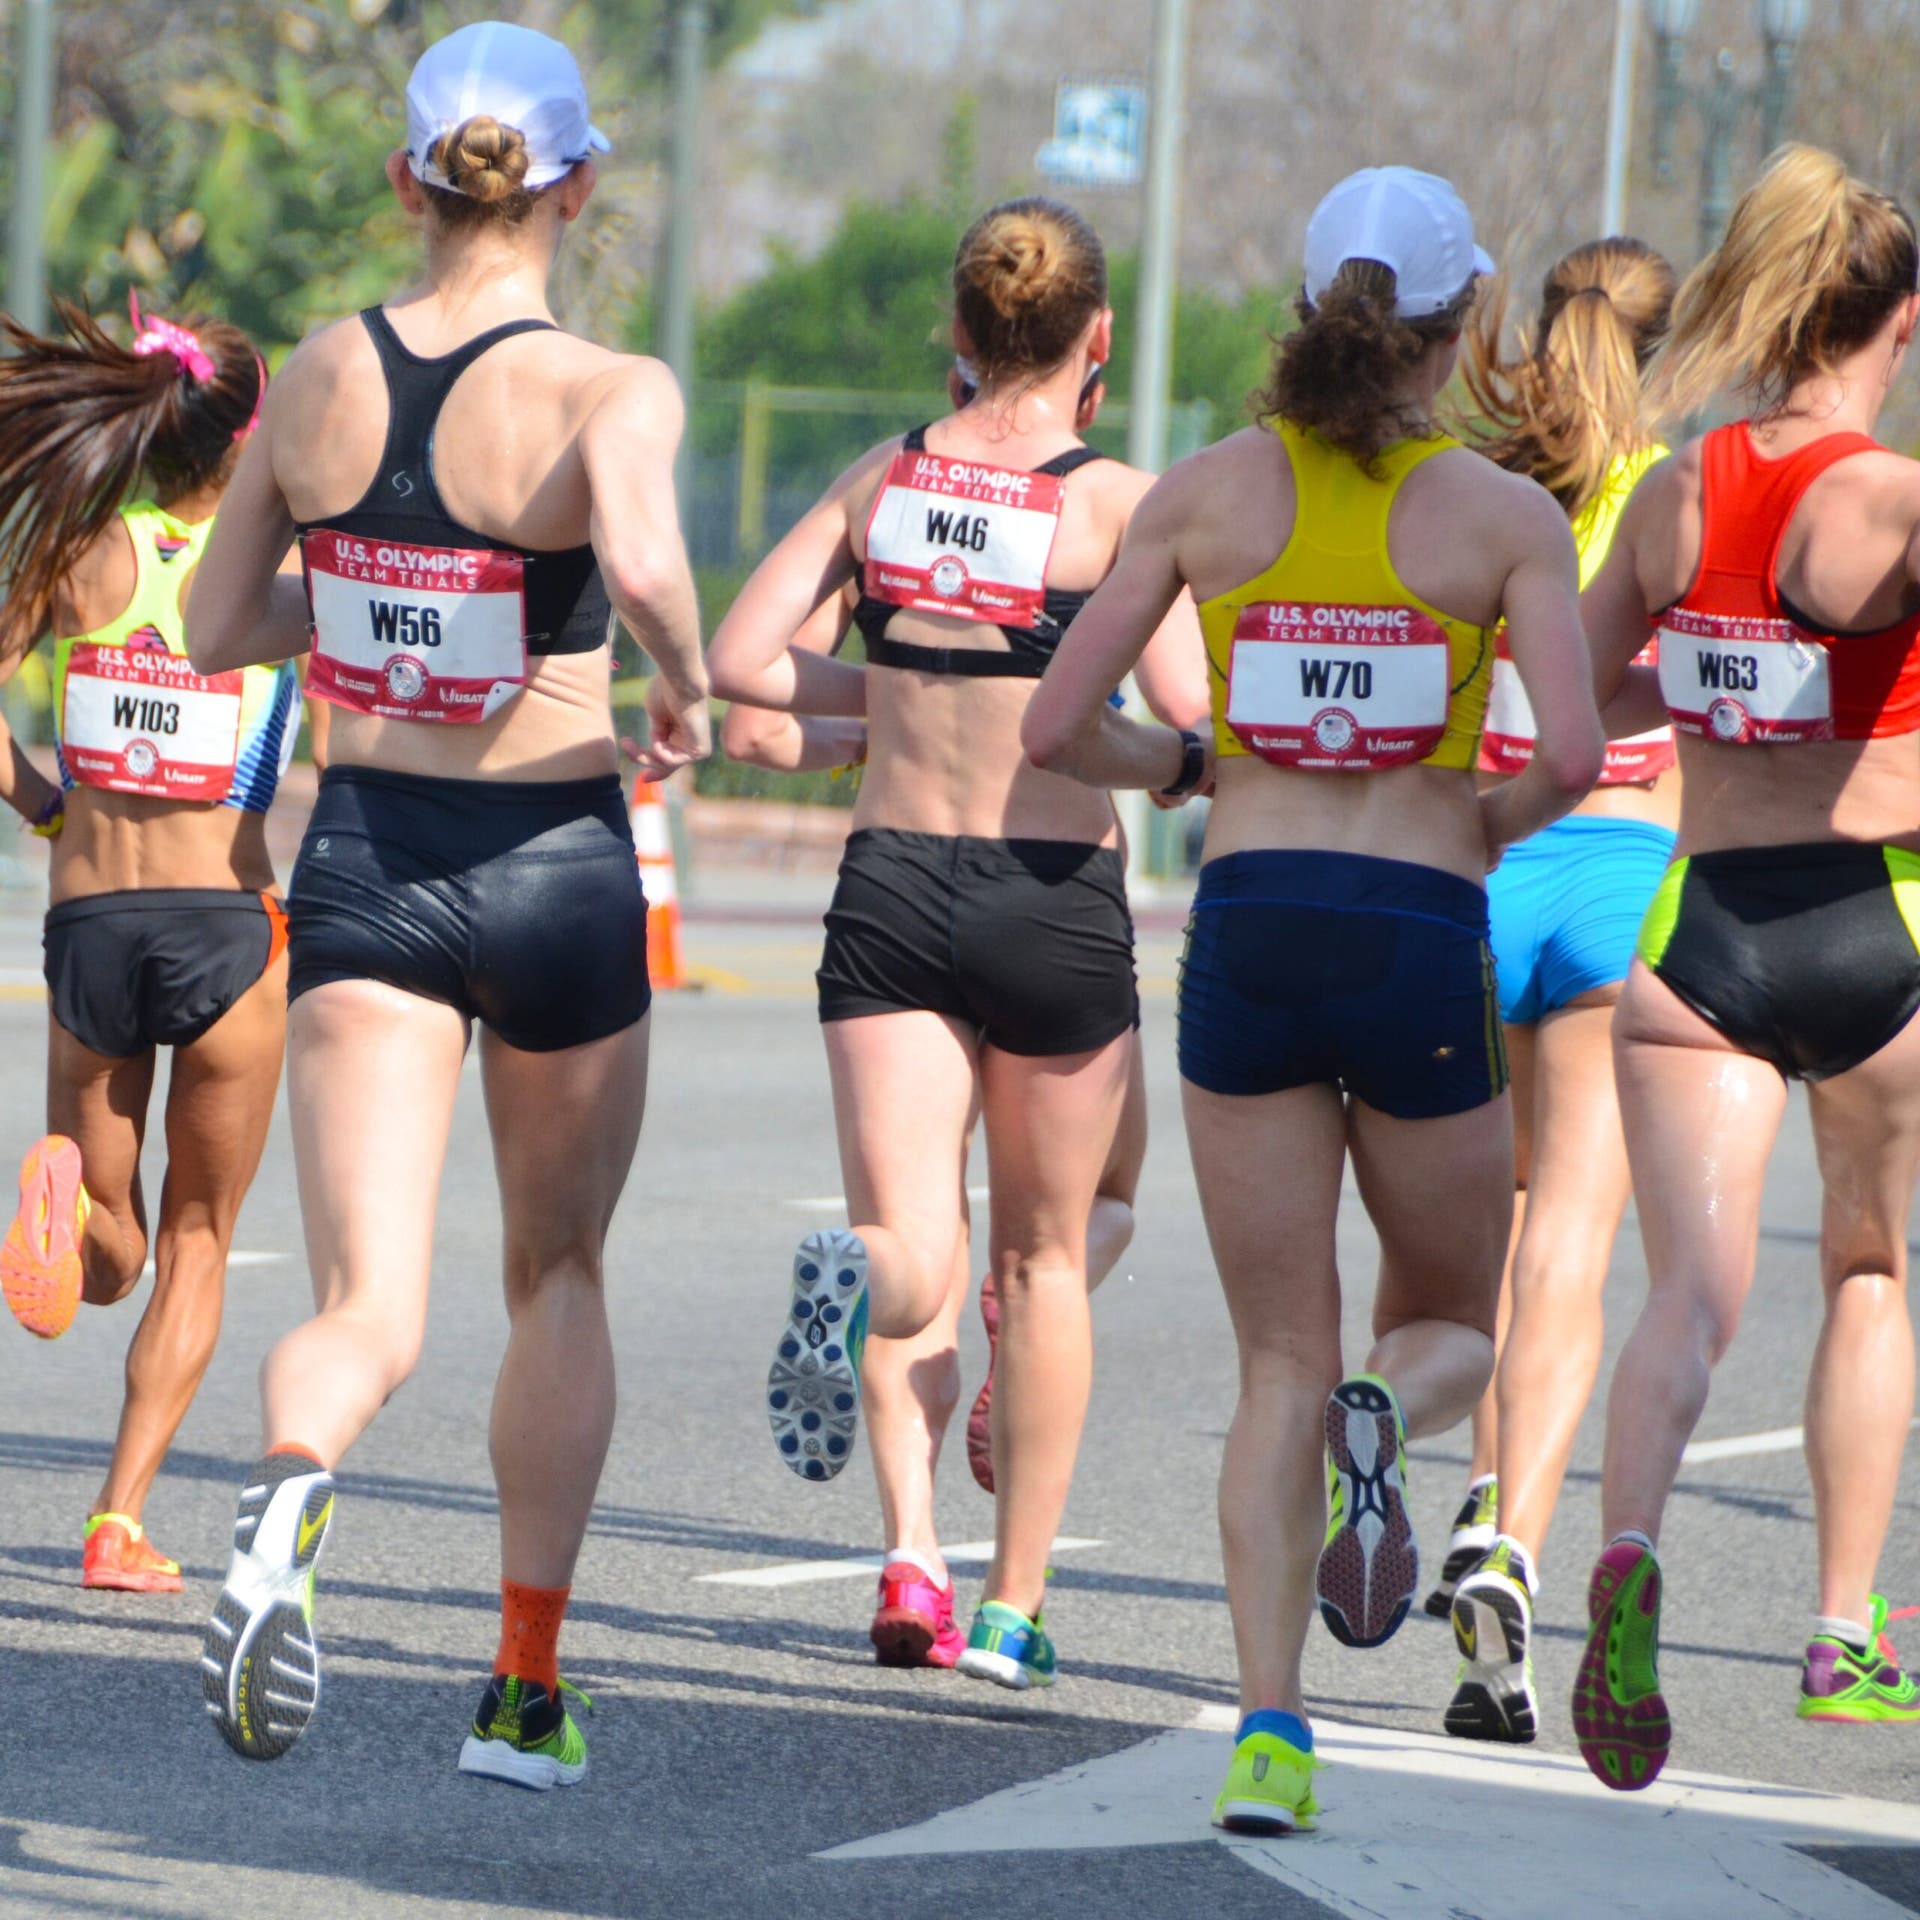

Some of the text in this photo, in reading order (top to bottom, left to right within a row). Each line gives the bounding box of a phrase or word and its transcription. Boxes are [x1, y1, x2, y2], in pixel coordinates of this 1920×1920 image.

[911, 475, 1026, 506] TEAM TRIALS
[916, 456, 1032, 494] U.S. OLYMPIC
[926, 508, 989, 551] W46
[335, 538, 478, 574] U.S. OLYMPIC
[336, 560, 478, 590] TEAM TRIALS
[368, 599, 441, 647] W56
[1268, 606, 1409, 627] U.S. OLYMPIC
[1672, 617, 1791, 639] TEAM TRIALS
[1267, 625, 1409, 642] TEAM TRIALS
[96, 663, 208, 690] TEAM TRIALS
[97, 646, 196, 676] U.S. OLYMP
[1698, 651, 1758, 691] W63
[1300, 659, 1372, 700] W70
[114, 694, 180, 735] W103
